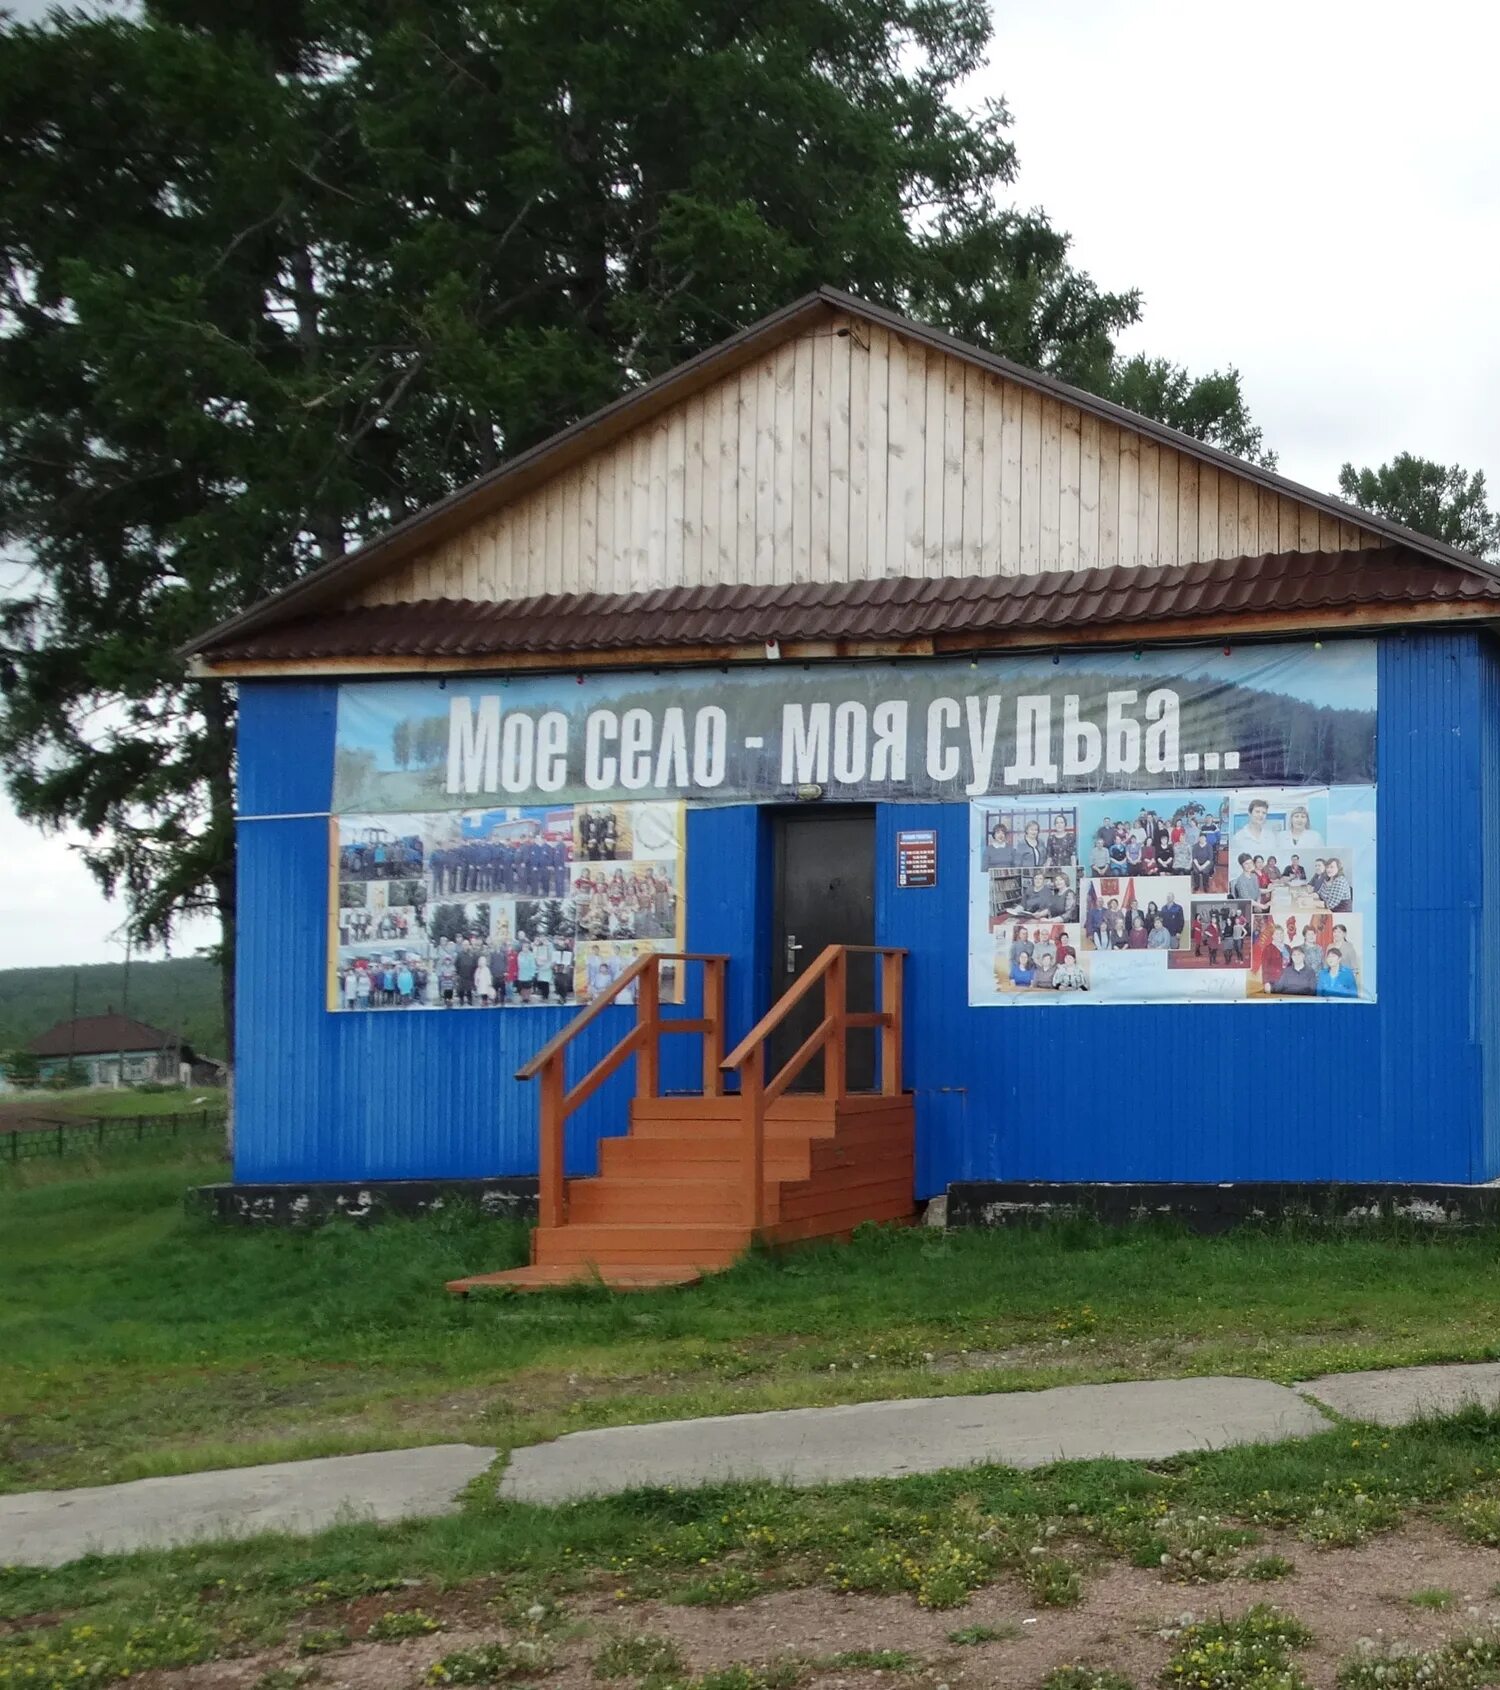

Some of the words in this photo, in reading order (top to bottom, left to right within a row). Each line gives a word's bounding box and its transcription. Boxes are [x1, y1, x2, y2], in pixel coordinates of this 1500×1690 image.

[446, 694, 568, 794] Мое
[584, 705, 727, 791] село
[781, 700, 908, 785] моя
